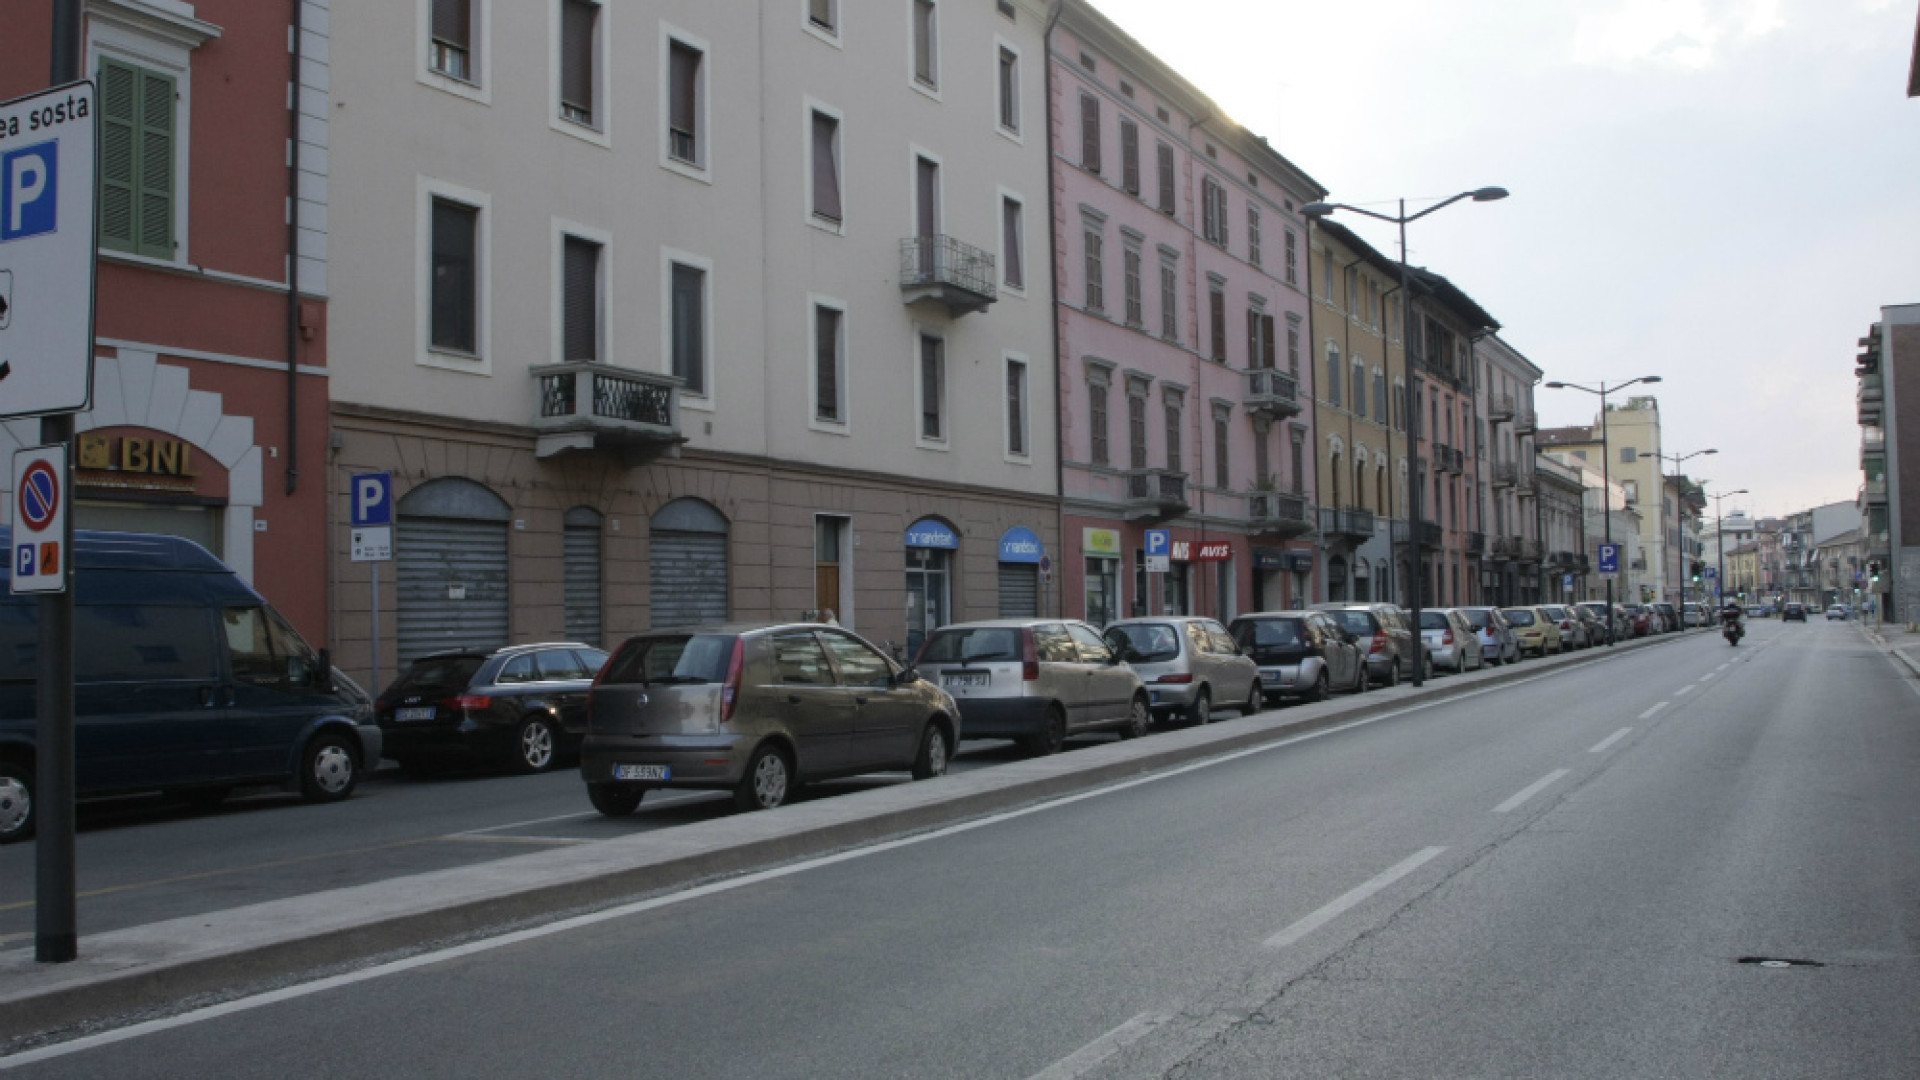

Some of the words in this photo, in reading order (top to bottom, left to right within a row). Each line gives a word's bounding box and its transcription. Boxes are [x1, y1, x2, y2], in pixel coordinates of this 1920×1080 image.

[30, 94, 88, 130] sosta
[11, 154, 47, 231] P
[358, 479, 384, 521] P
[1150, 532, 1165, 553] P
[1199, 545, 1228, 557] AVIS
[1602, 546, 1614, 562] P
[20, 548, 32, 573] P
[1564, 575, 1571, 584] P
